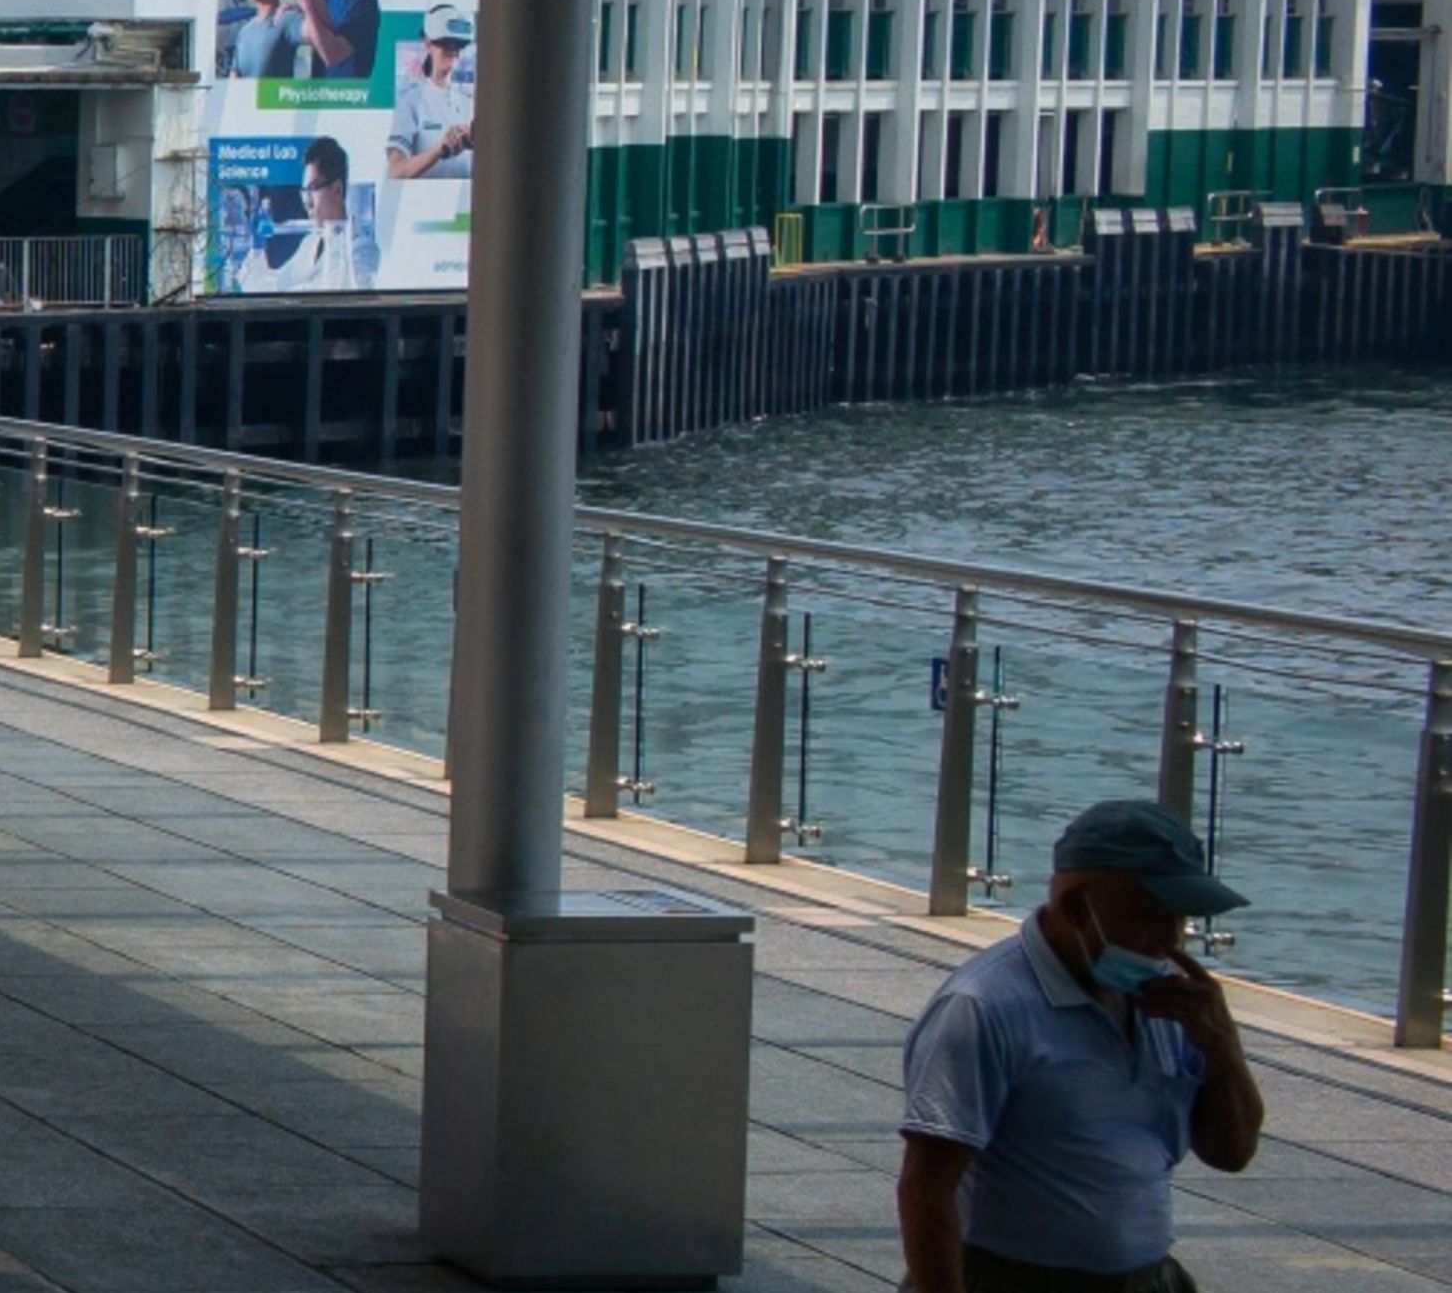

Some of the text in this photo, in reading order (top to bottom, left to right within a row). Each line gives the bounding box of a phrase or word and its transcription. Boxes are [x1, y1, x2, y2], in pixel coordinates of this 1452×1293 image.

[278, 86, 370, 104] Physiotherapy
[217, 144, 298, 160] Medical Lab
[218, 165, 269, 180] Science
